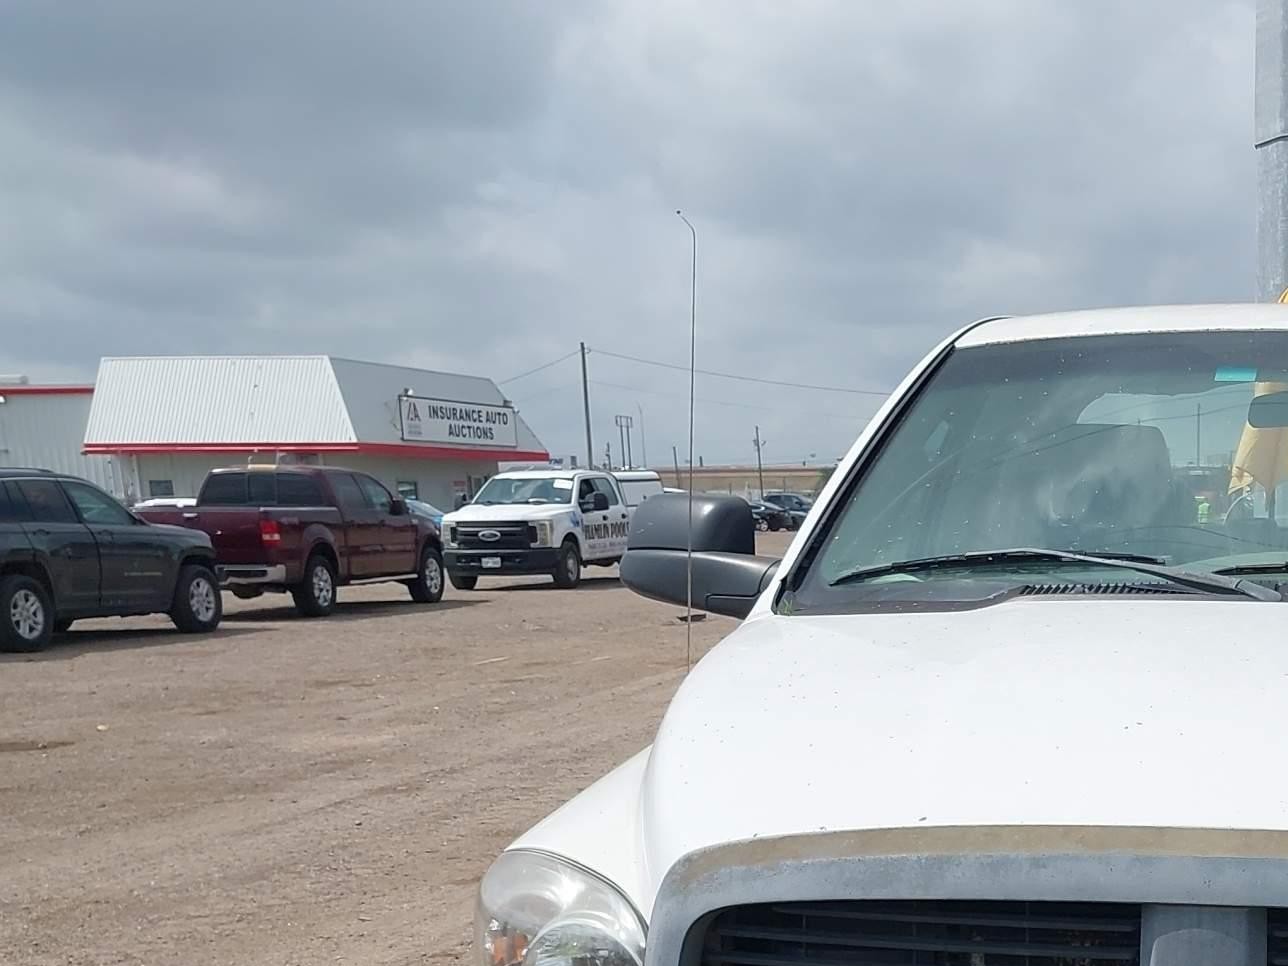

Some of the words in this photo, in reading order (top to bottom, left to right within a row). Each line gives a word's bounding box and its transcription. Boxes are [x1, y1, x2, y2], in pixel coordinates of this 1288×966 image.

[428, 405, 483, 424] INSURANCE
[485, 410, 509, 426] AUTO
[448, 423, 495, 440] AUCTIONS
